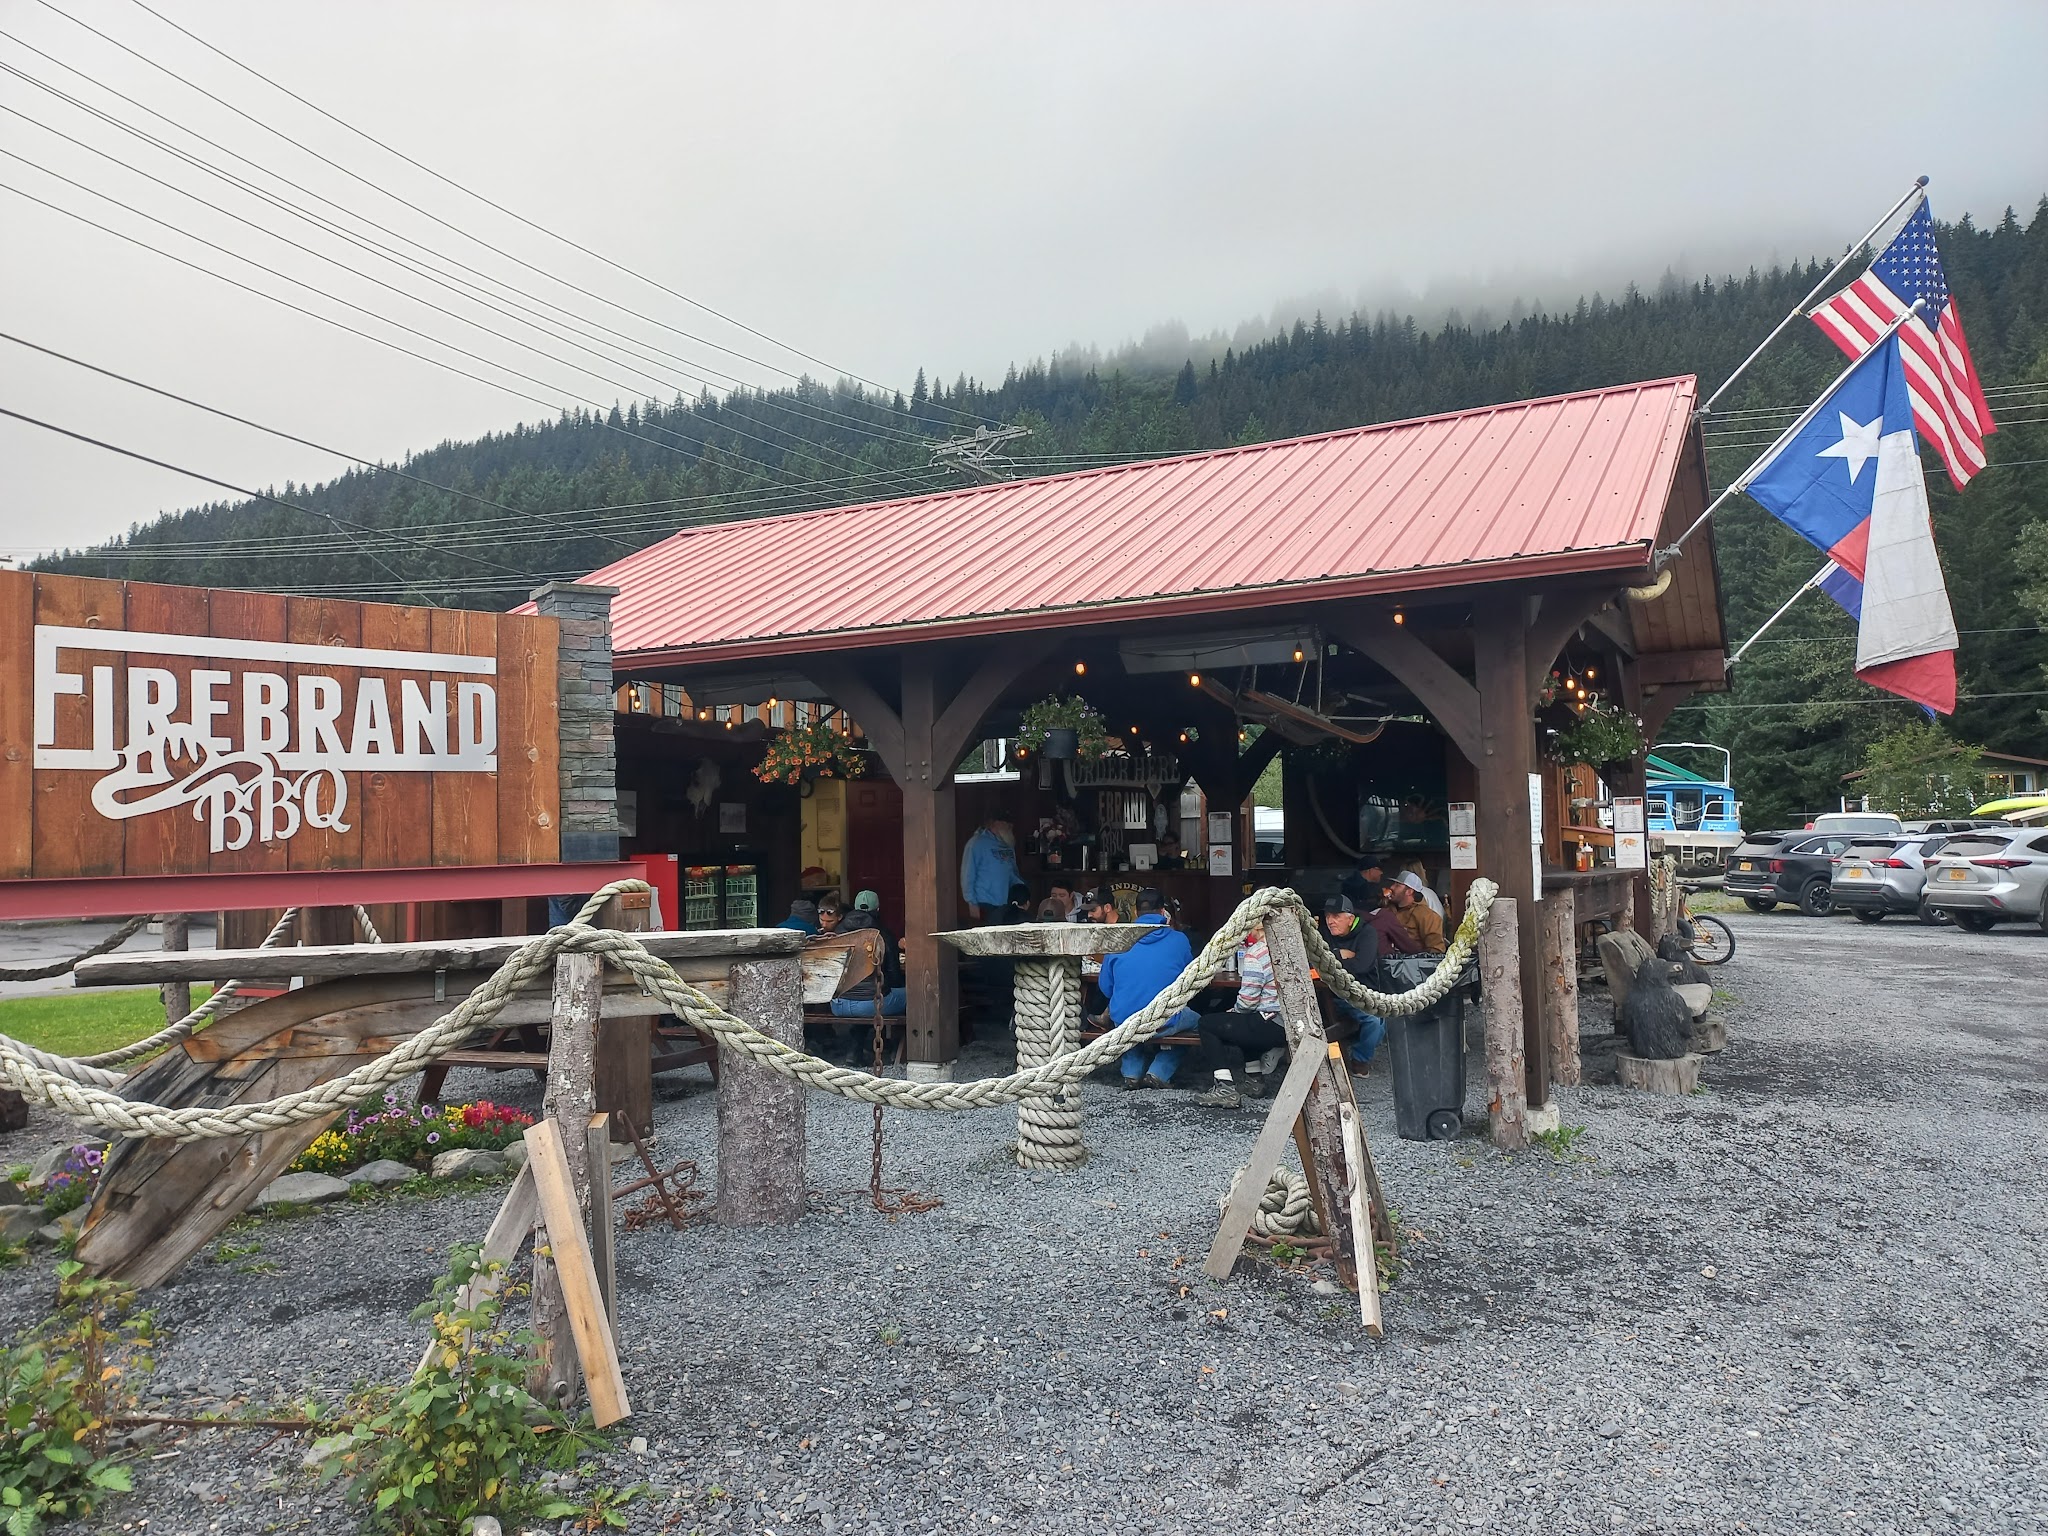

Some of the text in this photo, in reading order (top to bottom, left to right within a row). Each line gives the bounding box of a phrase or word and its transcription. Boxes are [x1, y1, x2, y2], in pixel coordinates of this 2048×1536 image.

[34, 625, 497, 770] FIREBRAND
[193, 768, 352, 854] BBQ
[1072, 756, 1180, 784] ORDER HERE
